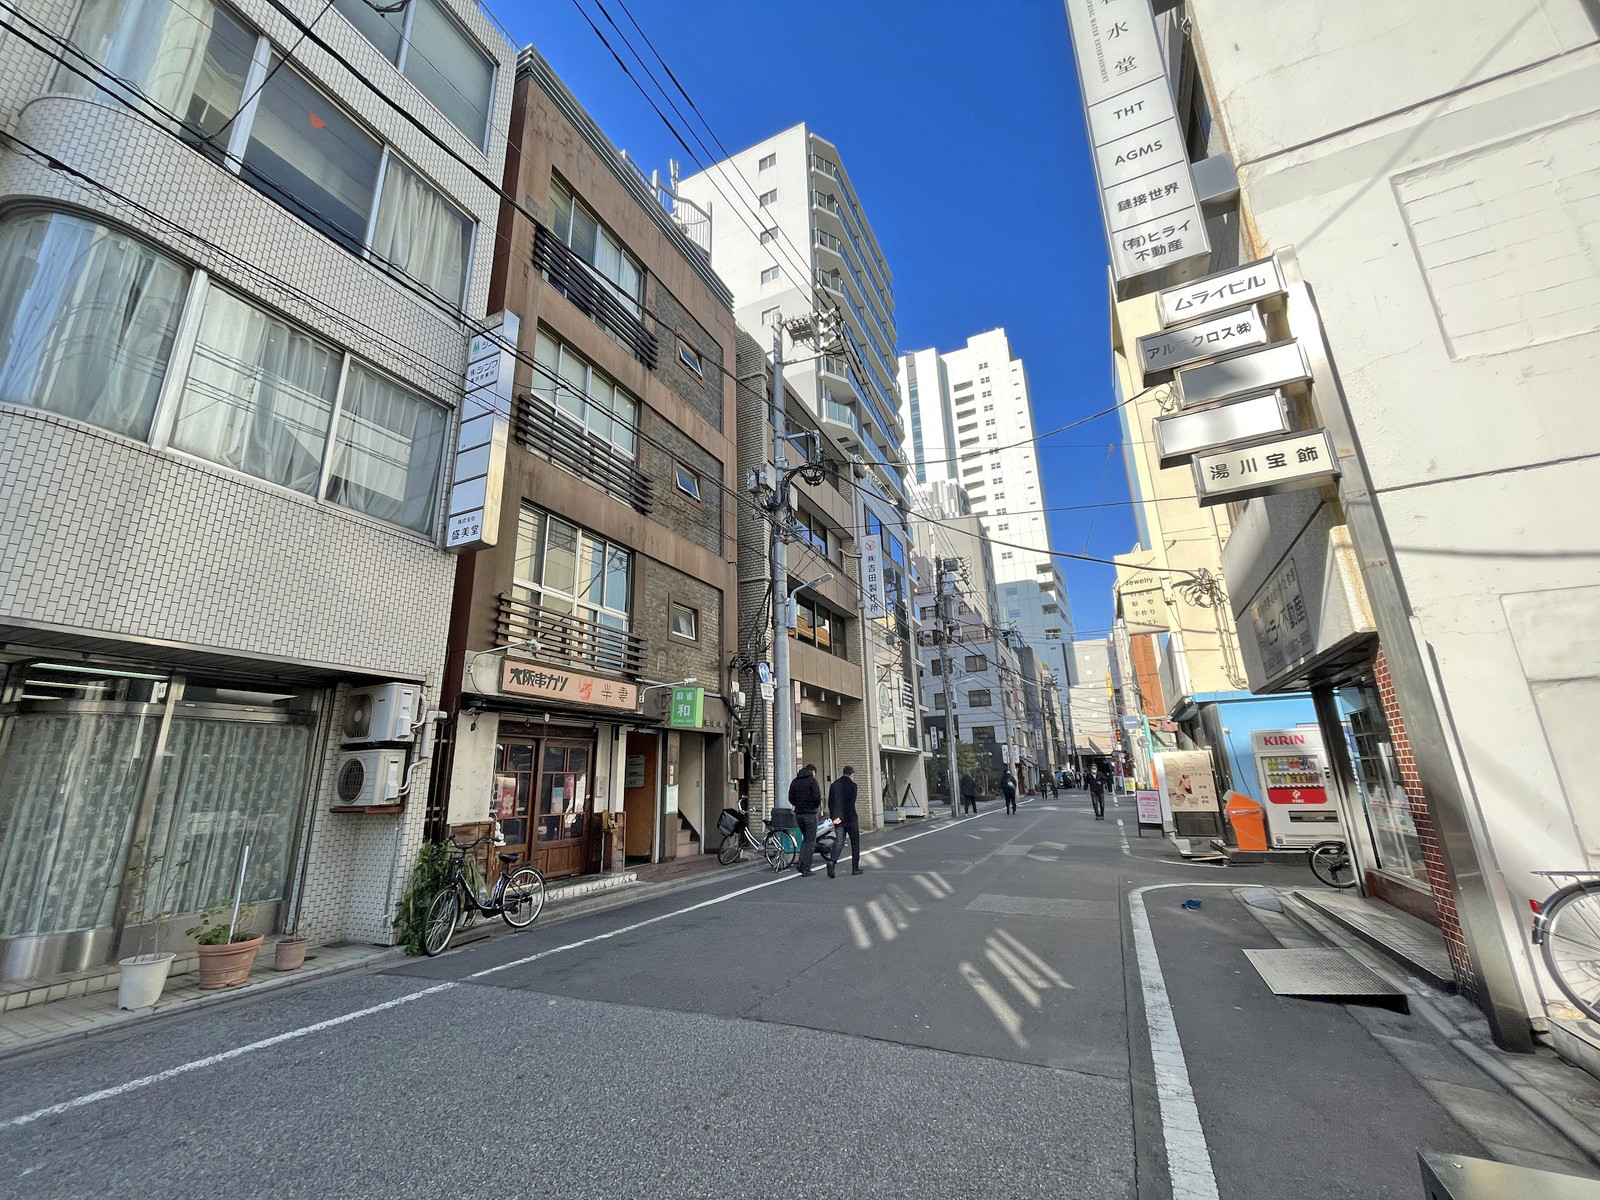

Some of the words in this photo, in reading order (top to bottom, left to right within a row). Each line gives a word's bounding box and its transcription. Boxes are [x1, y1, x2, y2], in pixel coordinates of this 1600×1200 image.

[1113, 100, 1144, 120] THT
[1114, 140, 1163, 166] AGMS
[1135, 239, 1184, 261] 不動産
[1174, 276, 1266, 312] ムライビル
[1210, 446, 1319, 480] 湯川宝飾
[451, 524, 480, 541] 盛美堂
[1125, 577, 1153, 586] Jewelry
[509, 667, 569, 692] 大阪串カツ
[677, 703, 691, 717] 和
[1263, 735, 1306, 746] KIRIN
